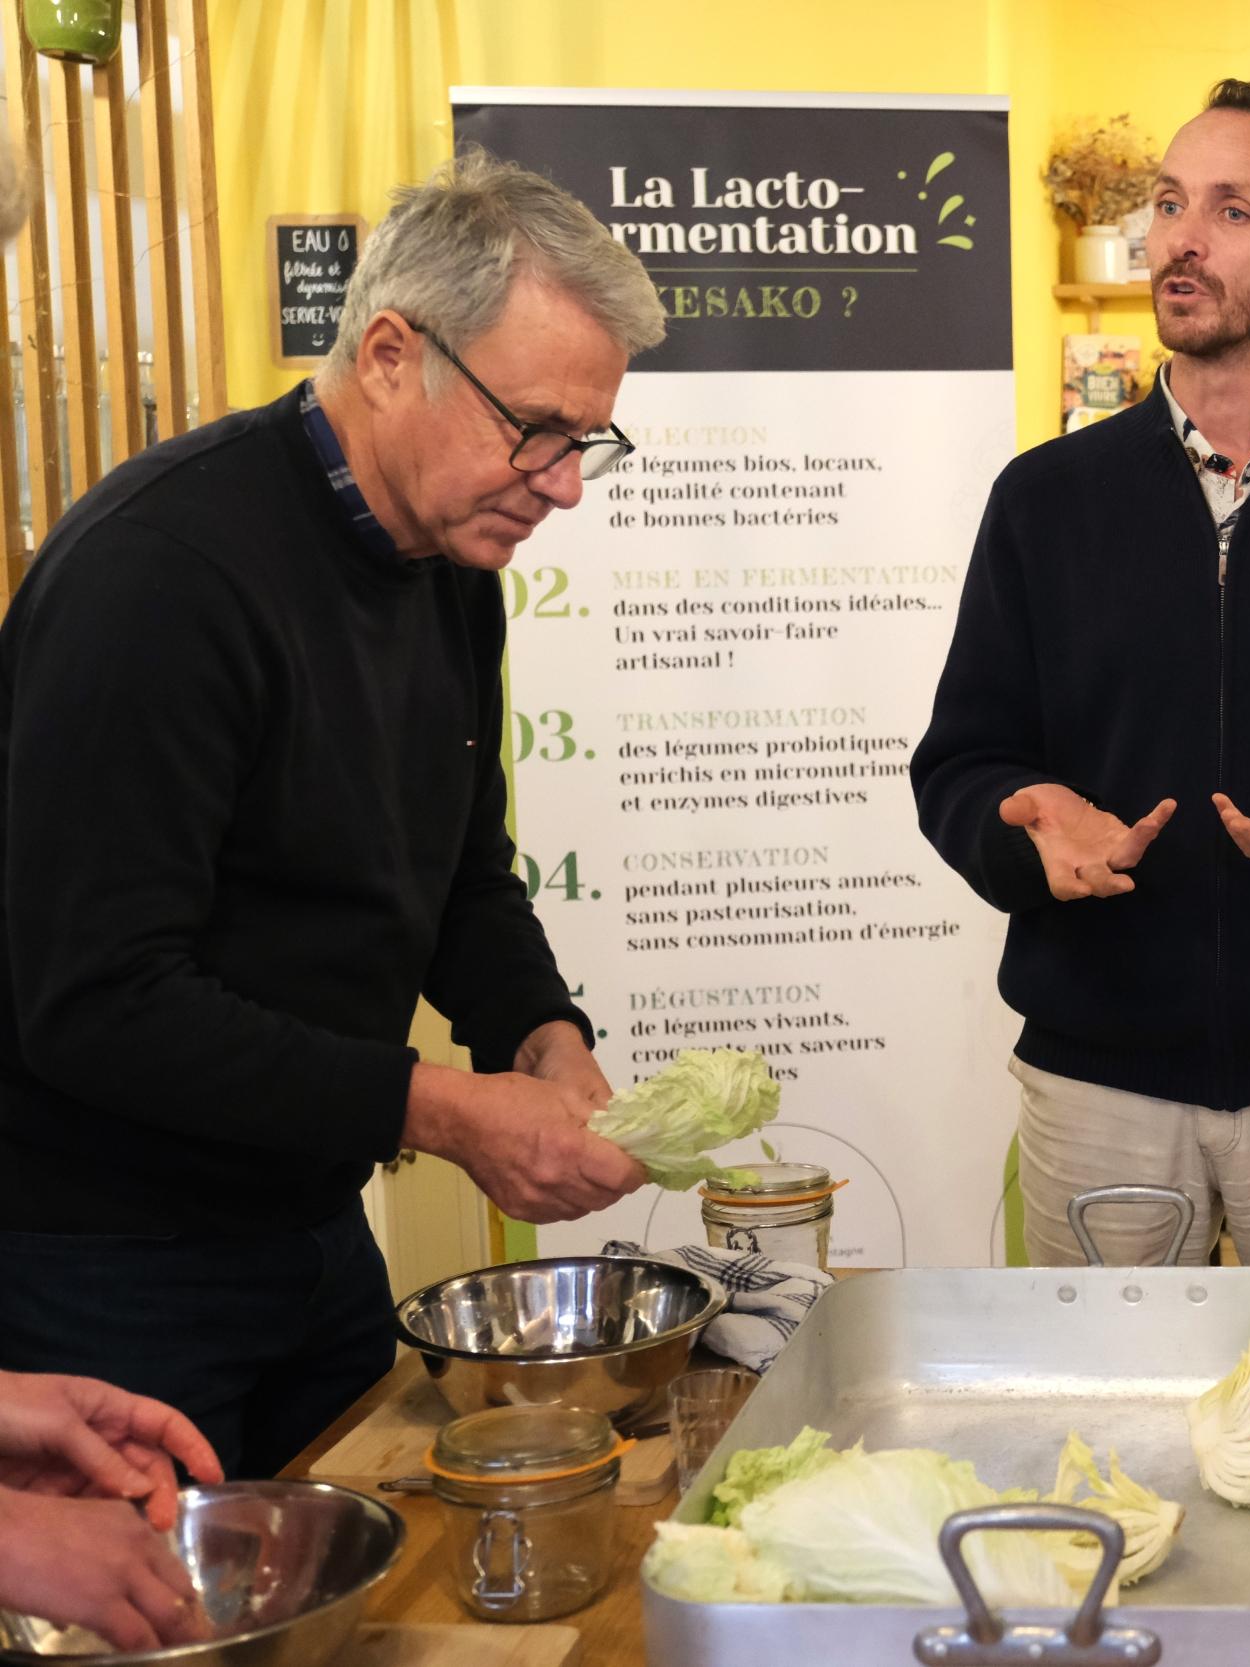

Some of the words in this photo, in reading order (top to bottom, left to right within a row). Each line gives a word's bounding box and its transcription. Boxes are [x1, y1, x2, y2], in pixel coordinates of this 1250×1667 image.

[609, 166, 676, 209] La
[292, 229, 331, 253] EAU
[609, 213, 919, 255] rmentation
[842, 286, 859, 318] ?
[625, 425, 768, 447] ÉLECTION
[642, 456, 737, 478] légumes
[609, 483, 635, 501] de
[642, 482, 723, 505] qualité
[730, 482, 847, 500] contenant
[609, 511, 636, 529] de
[643, 510, 726, 528] bonnes
[733, 508, 839, 527] bactéries
[612, 569, 681, 590] MISE
[694, 568, 730, 589] EN
[743, 564, 958, 587] FERMENTATION
[613, 598, 669, 618] dans
[675, 597, 714, 616] des
[721, 595, 841, 615] conditions
[615, 626, 645, 645] Un
[653, 625, 697, 643] vrai
[704, 622, 839, 643] savoir-faire
[615, 652, 721, 671] artisanal
[617, 706, 867, 732] TRANSFORMATION
[619, 741, 657, 760] des
[664, 738, 759, 760] légumes
[766, 734, 909, 759] probiotiques
[620, 767, 713, 787] enrichis
[720, 768, 748, 784] en
[754, 761, 910, 783] micronutrime
[621, 795, 642, 813] et
[650, 792, 749, 815] enzymes
[755, 787, 868, 811] digestives
[623, 846, 830, 873] CONSERVATION
[625, 879, 717, 904] pendant
[725, 874, 831, 899] plusieurs
[625, 908, 679, 926] sans
[626, 934, 680, 952] sans
[686, 926, 853, 950] consommation
[859, 919, 961, 945] d'énergie
[629, 983, 821, 1012] DÉGUSTATION
[631, 1019, 657, 1038] de
[664, 1015, 757, 1038] légumes
[800, 1036, 886, 1054] saveurs
